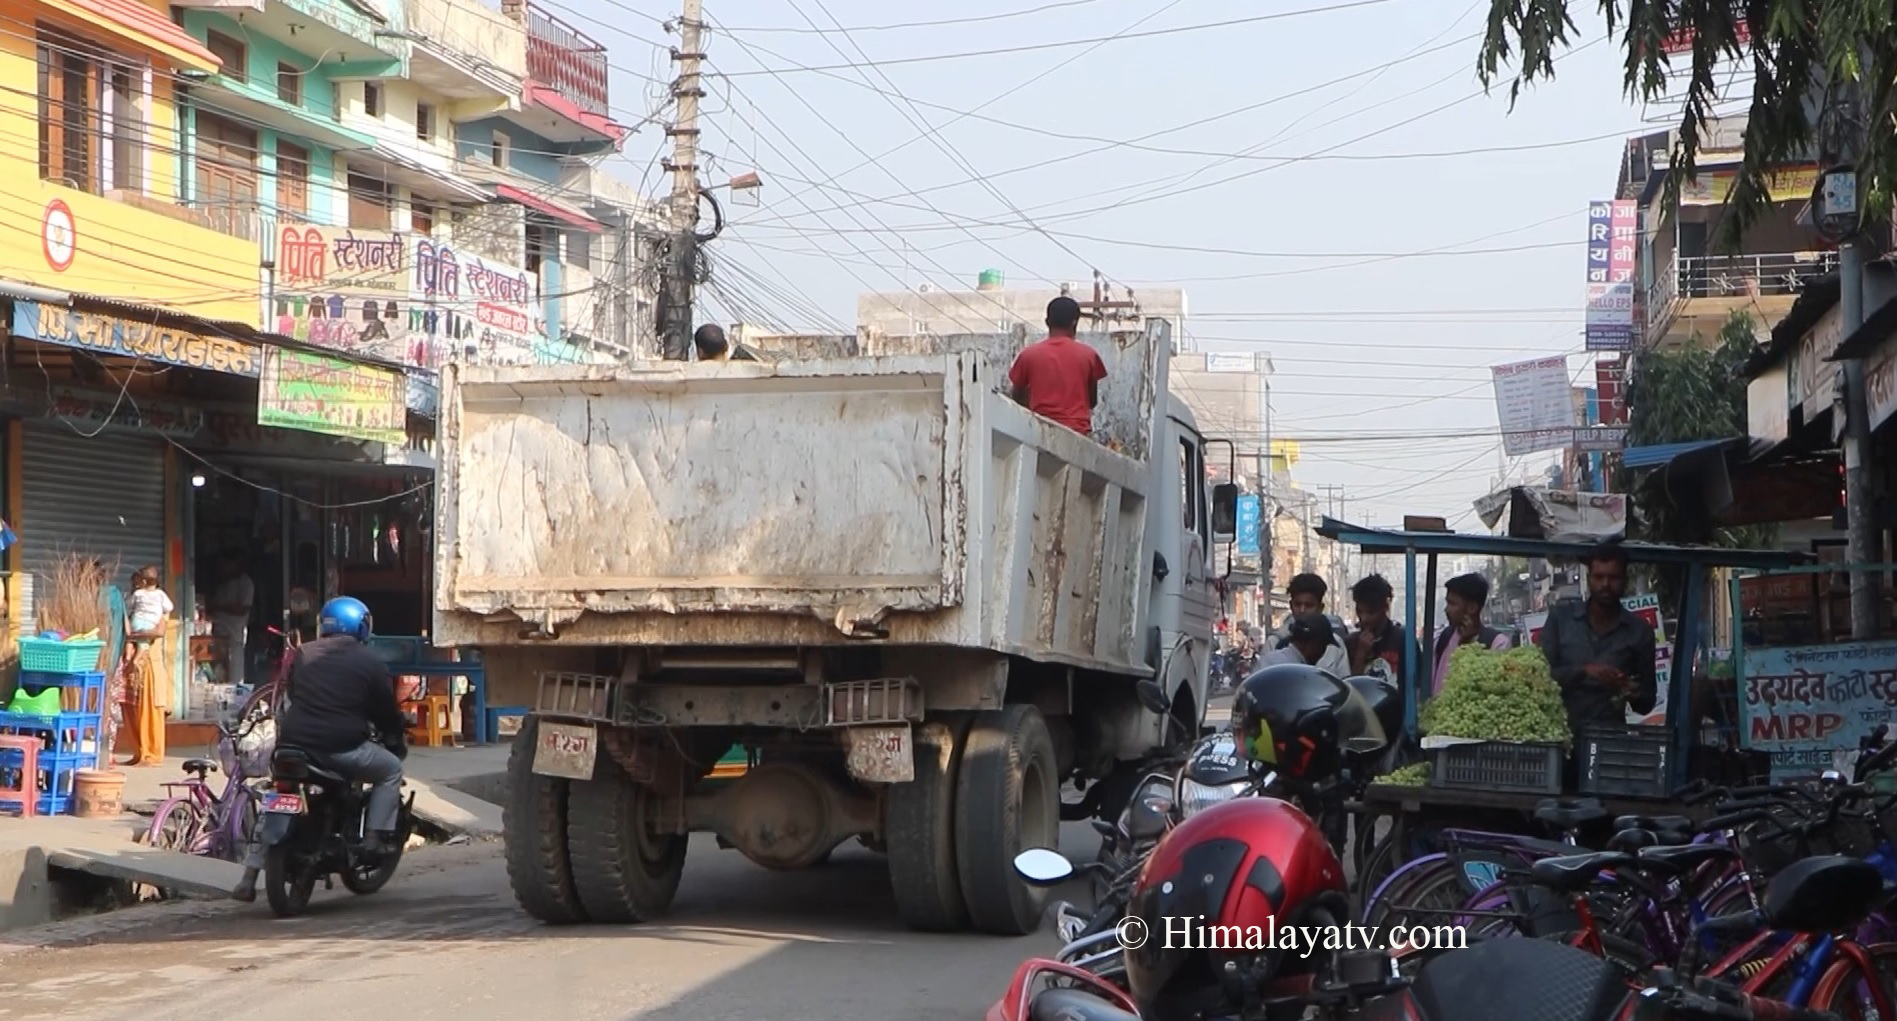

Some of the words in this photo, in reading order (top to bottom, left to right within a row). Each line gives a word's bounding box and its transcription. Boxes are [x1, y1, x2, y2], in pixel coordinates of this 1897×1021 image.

[333, 230, 404, 274] स्टेशनरी
[465, 258, 529, 308] स्टेशनरी
[1616, 298, 1631, 308] EPS
[1575, 429, 1598, 441] HELP
[1600, 428, 1628, 441] NEPA
[1752, 713, 1842, 741] MRP
